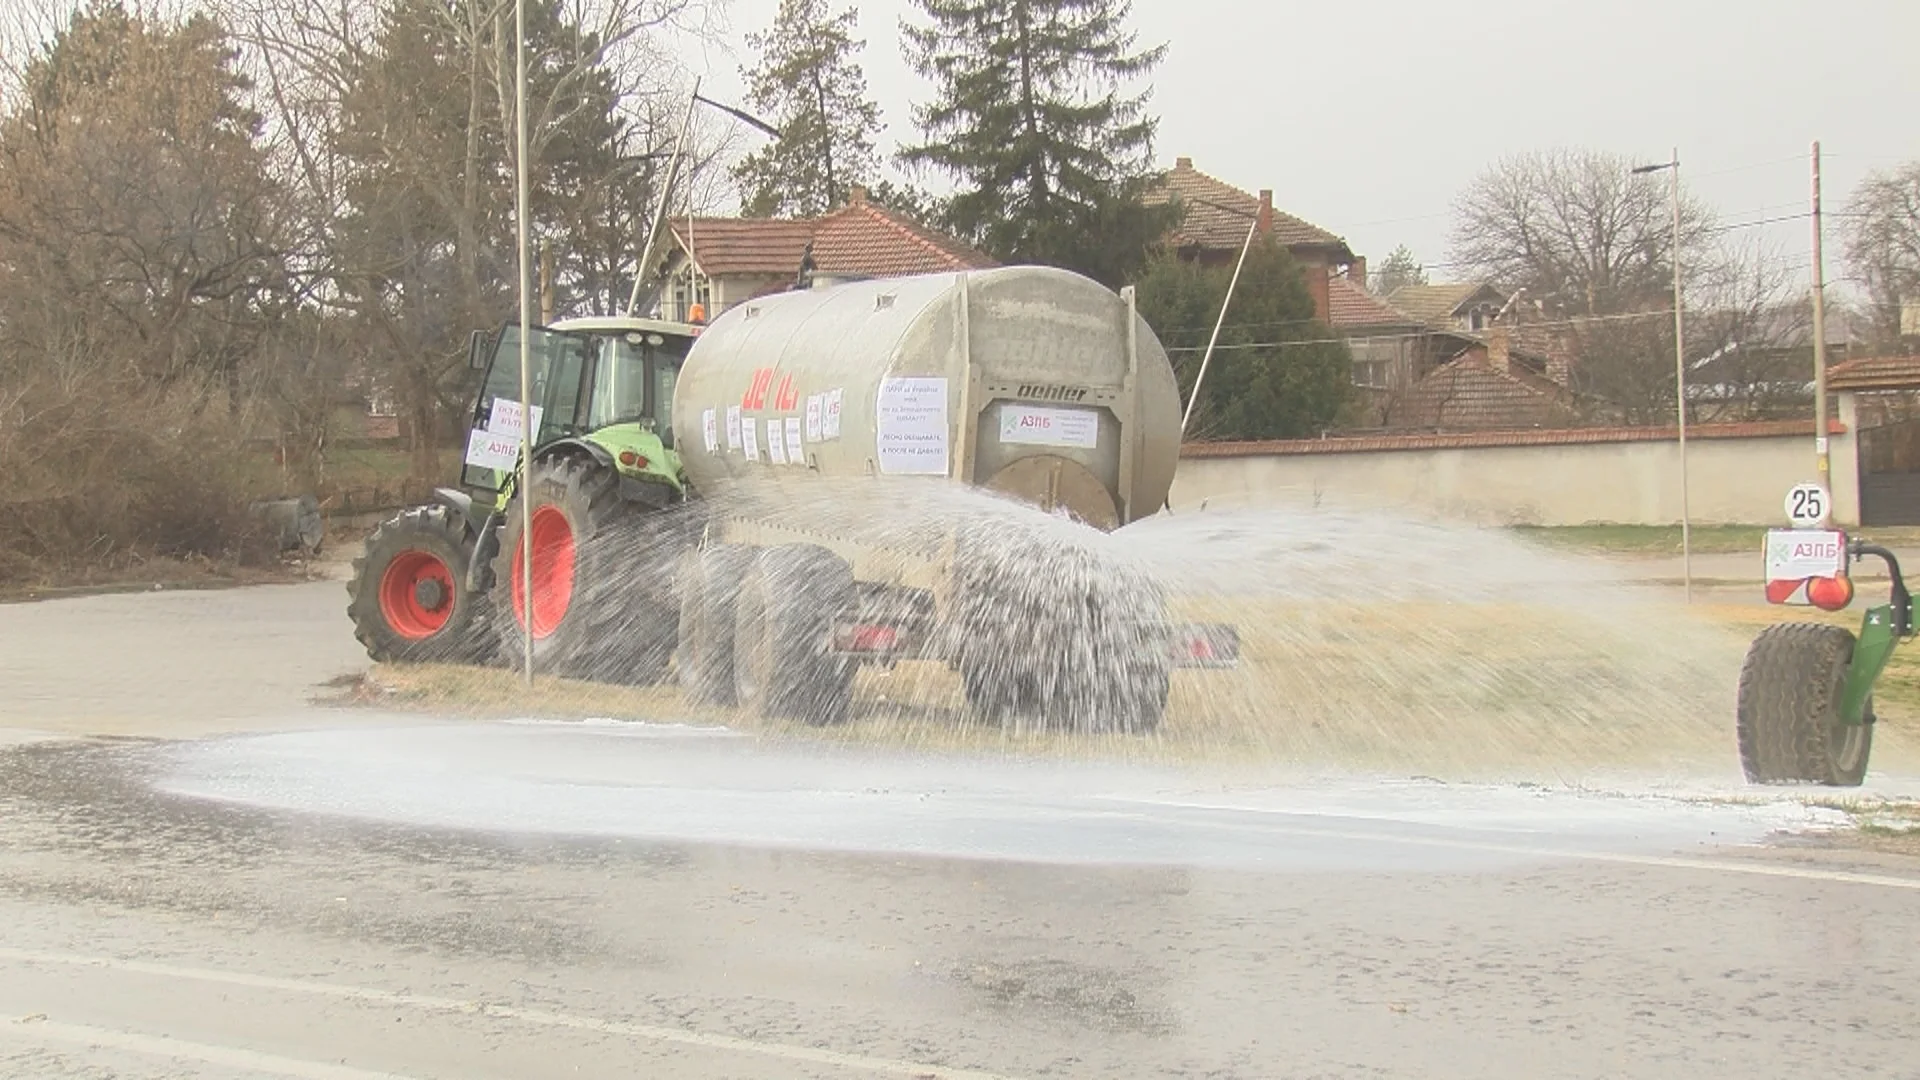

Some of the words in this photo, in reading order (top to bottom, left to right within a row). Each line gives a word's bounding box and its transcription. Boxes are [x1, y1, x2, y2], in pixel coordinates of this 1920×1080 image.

[1020, 415, 1051, 429] АЗПБ
[488, 441, 516, 456] АЗПБ
[1792, 489, 1821, 519] 25
[1793, 543, 1837, 558] АЗПБ
